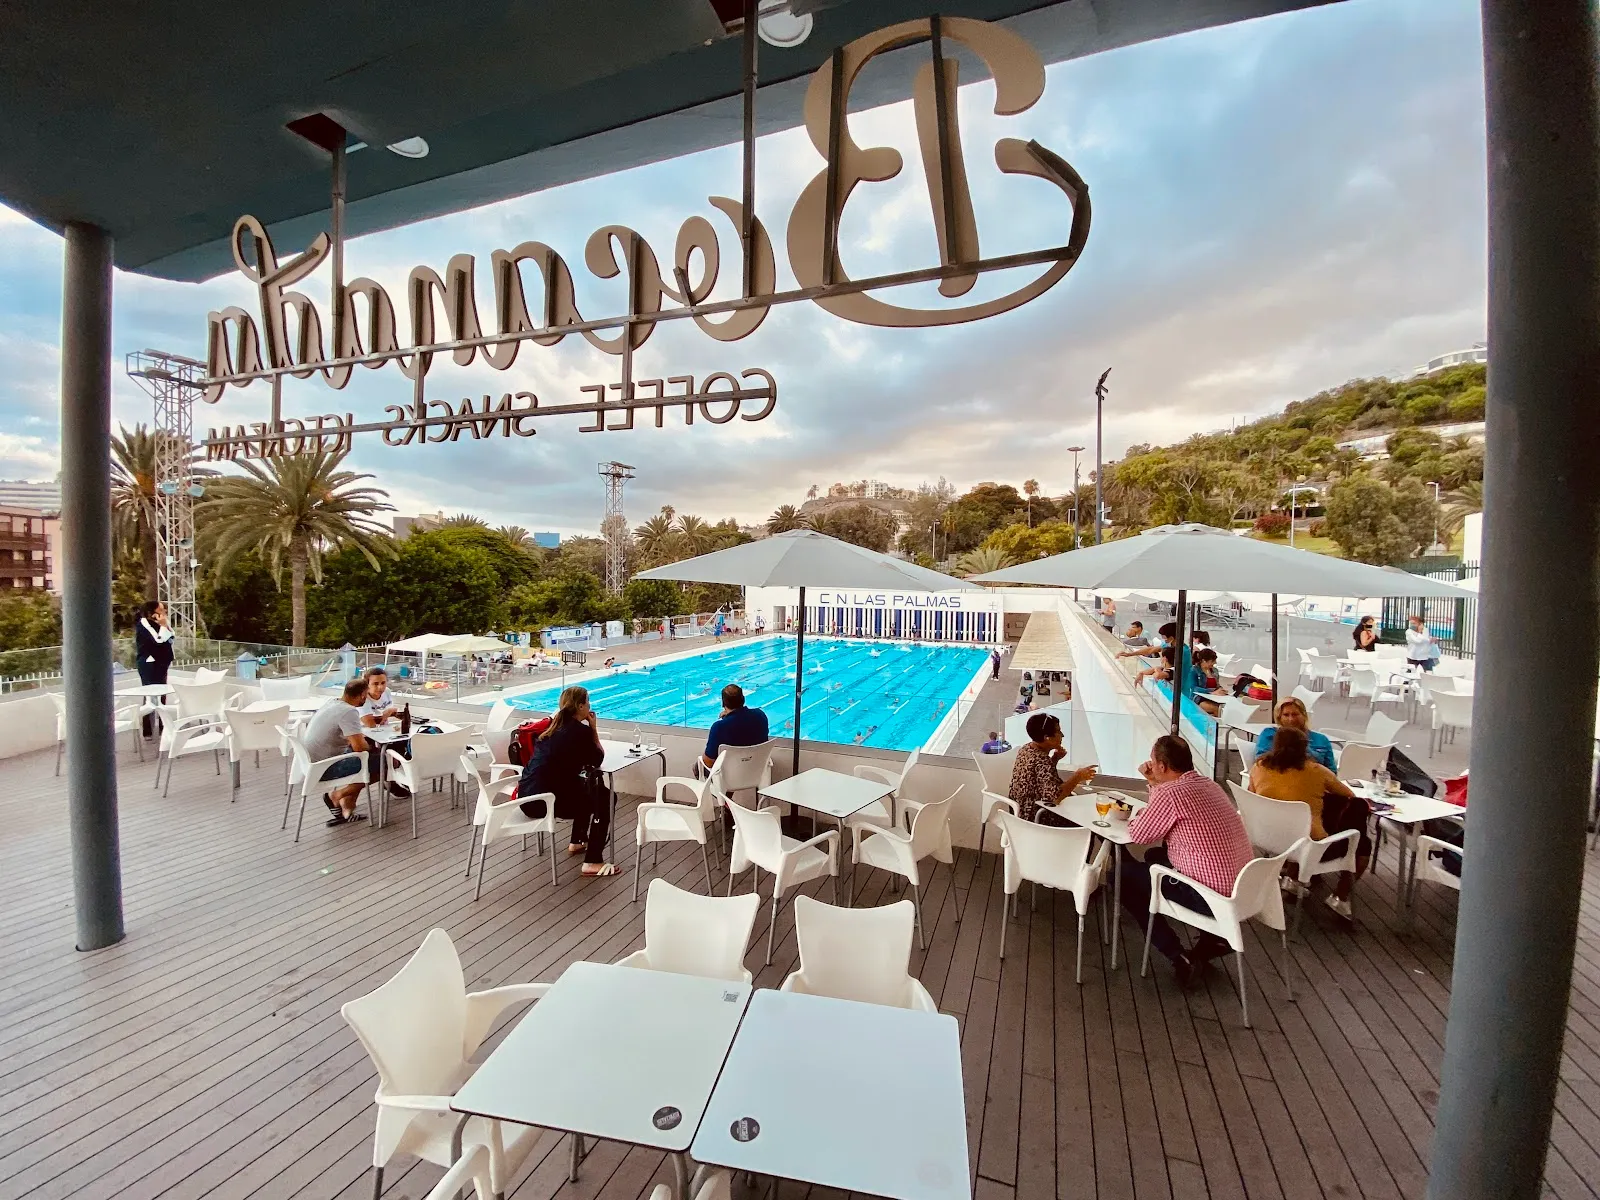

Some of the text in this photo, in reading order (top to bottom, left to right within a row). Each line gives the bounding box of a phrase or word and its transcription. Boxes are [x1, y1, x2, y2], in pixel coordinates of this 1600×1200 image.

[820, 593, 961, 608] C N LAS PALMAS
